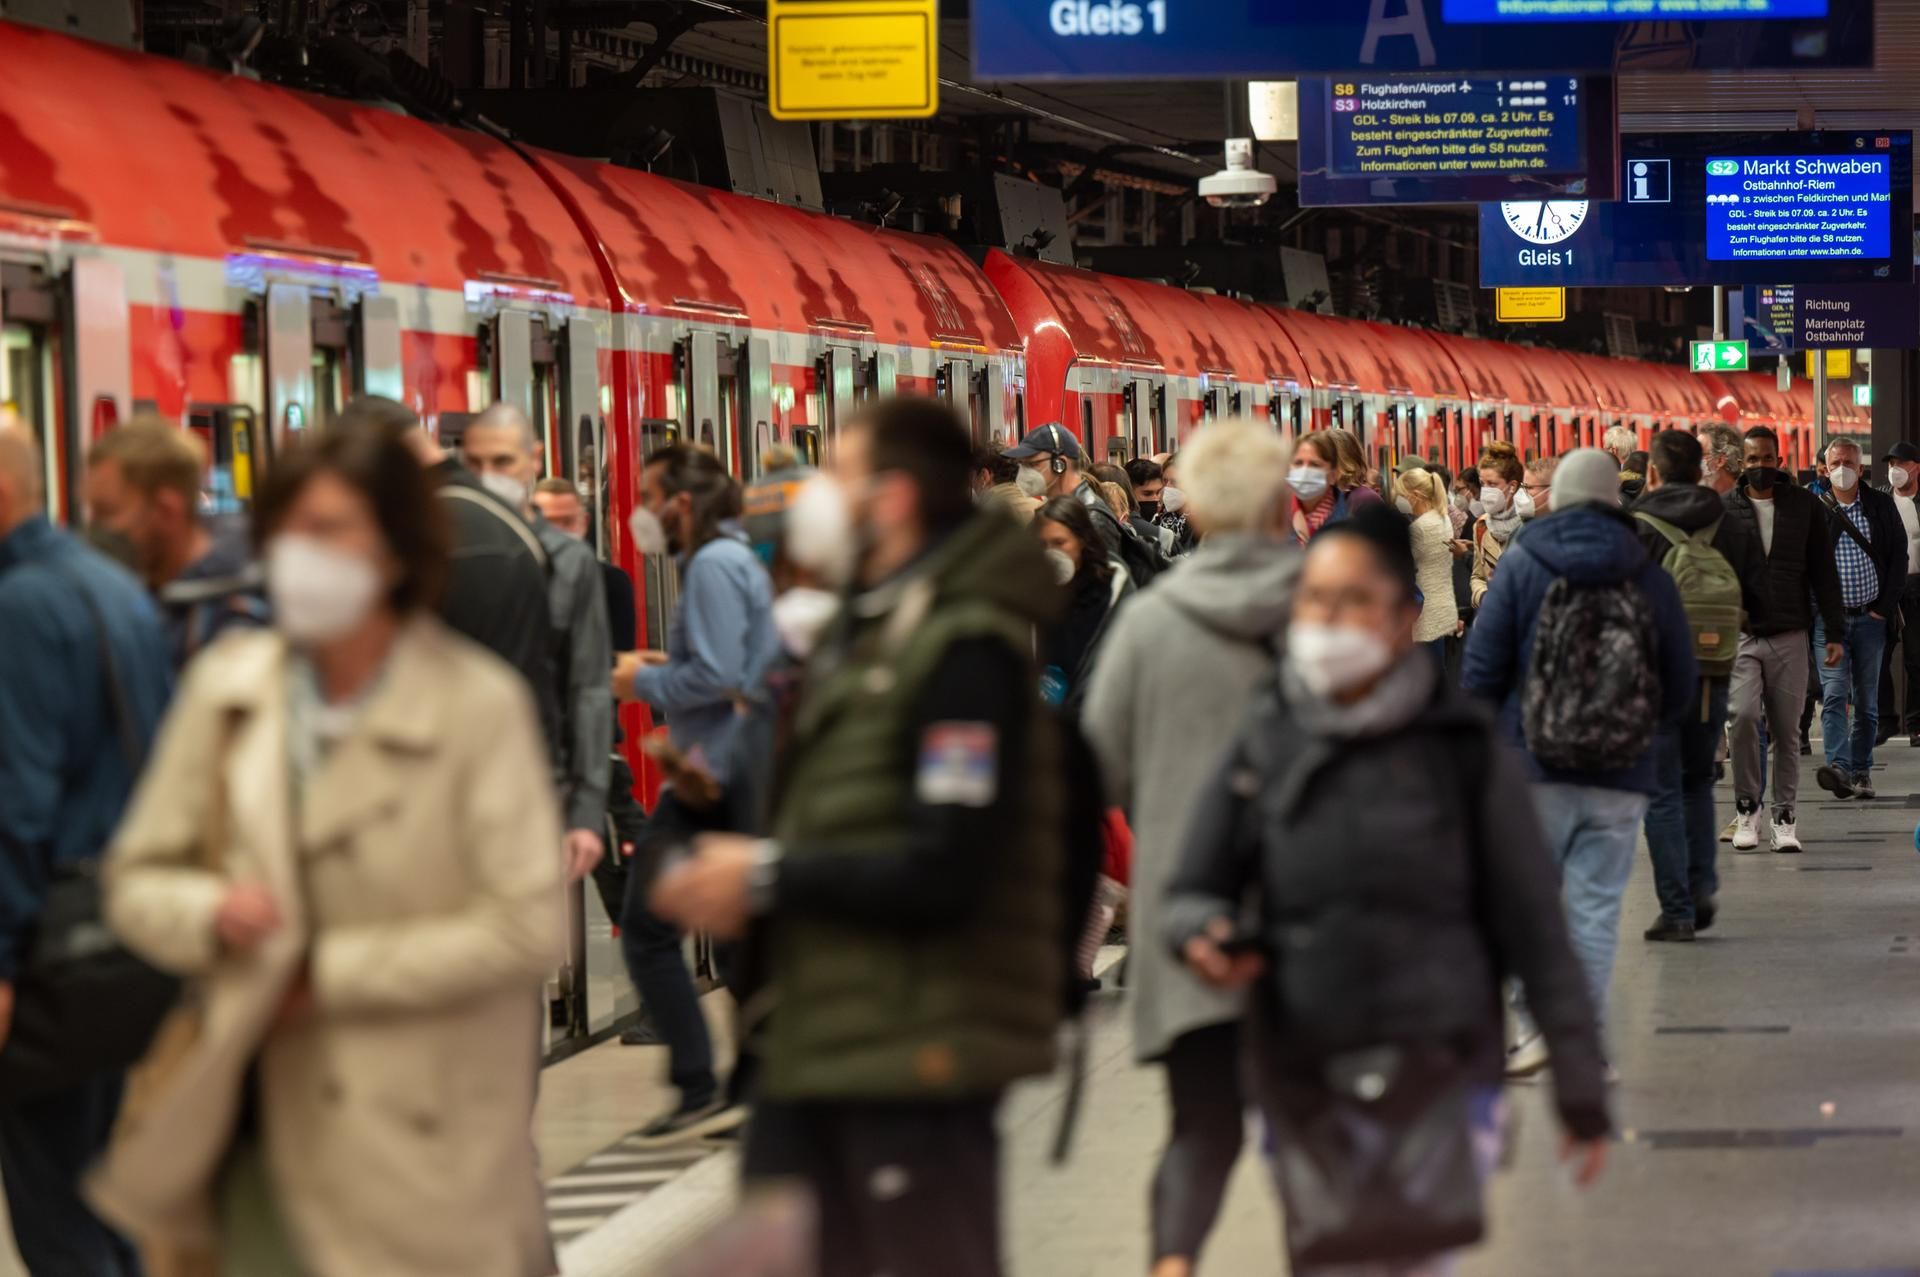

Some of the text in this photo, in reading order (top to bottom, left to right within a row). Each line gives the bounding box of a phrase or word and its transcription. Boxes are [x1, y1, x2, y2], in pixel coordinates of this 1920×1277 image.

[1049, 0, 1167, 36] Gleis 1
[1359, 0, 1436, 66] A
[1334, 80, 1577, 96] S8 Flughafen/Airport 1 3
[1335, 96, 1576, 111] S3 Holzkirchen 1 11
[1353, 115, 1378, 126] GDL
[1390, 114, 1421, 124] Streik
[1424, 113, 1440, 123] bis
[1443, 113, 1477, 123] 07.09.
[1481, 114, 1498, 123] ca.
[1502, 112, 1508, 123] 2
[1512, 112, 1535, 122] Uhr.
[1539, 111, 1554, 121] Es
[1352, 127, 1552, 141] besteht eingeschränkter Zugverkehr.
[1876, 138, 1889, 147] DB
[1356, 142, 1547, 158] Zum Flughafen bitte die S8 nutzen.
[1361, 158, 1547, 171] Informationen unter www.bahn.de.
[1713, 159, 1881, 175] S2 Markt Schwaben
[1744, 180, 1835, 190] Ostbahnhof-Riem
[1753, 195, 1794, 203] zwischen
[1797, 193, 1848, 202] Feldkirchen
[1852, 193, 1868, 201] und
[1778, 209, 1789, 217] bis
[1792, 209, 1815, 217] 07.09.
[1727, 222, 1867, 231] besteht eingeschränkter Zugverkehr.
[1730, 236, 1748, 244] Zum
[1750, 235, 1788, 244] Flughafen
[1790, 235, 1807, 243] bitte
[1518, 250, 1572, 265] Gleis 1
[1733, 248, 1786, 256] Informationen
[1805, 299, 1850, 312] Richtung
[1805, 319, 1865, 330] Marienplatz
[1805, 331, 1864, 342] Ostbahnhof
